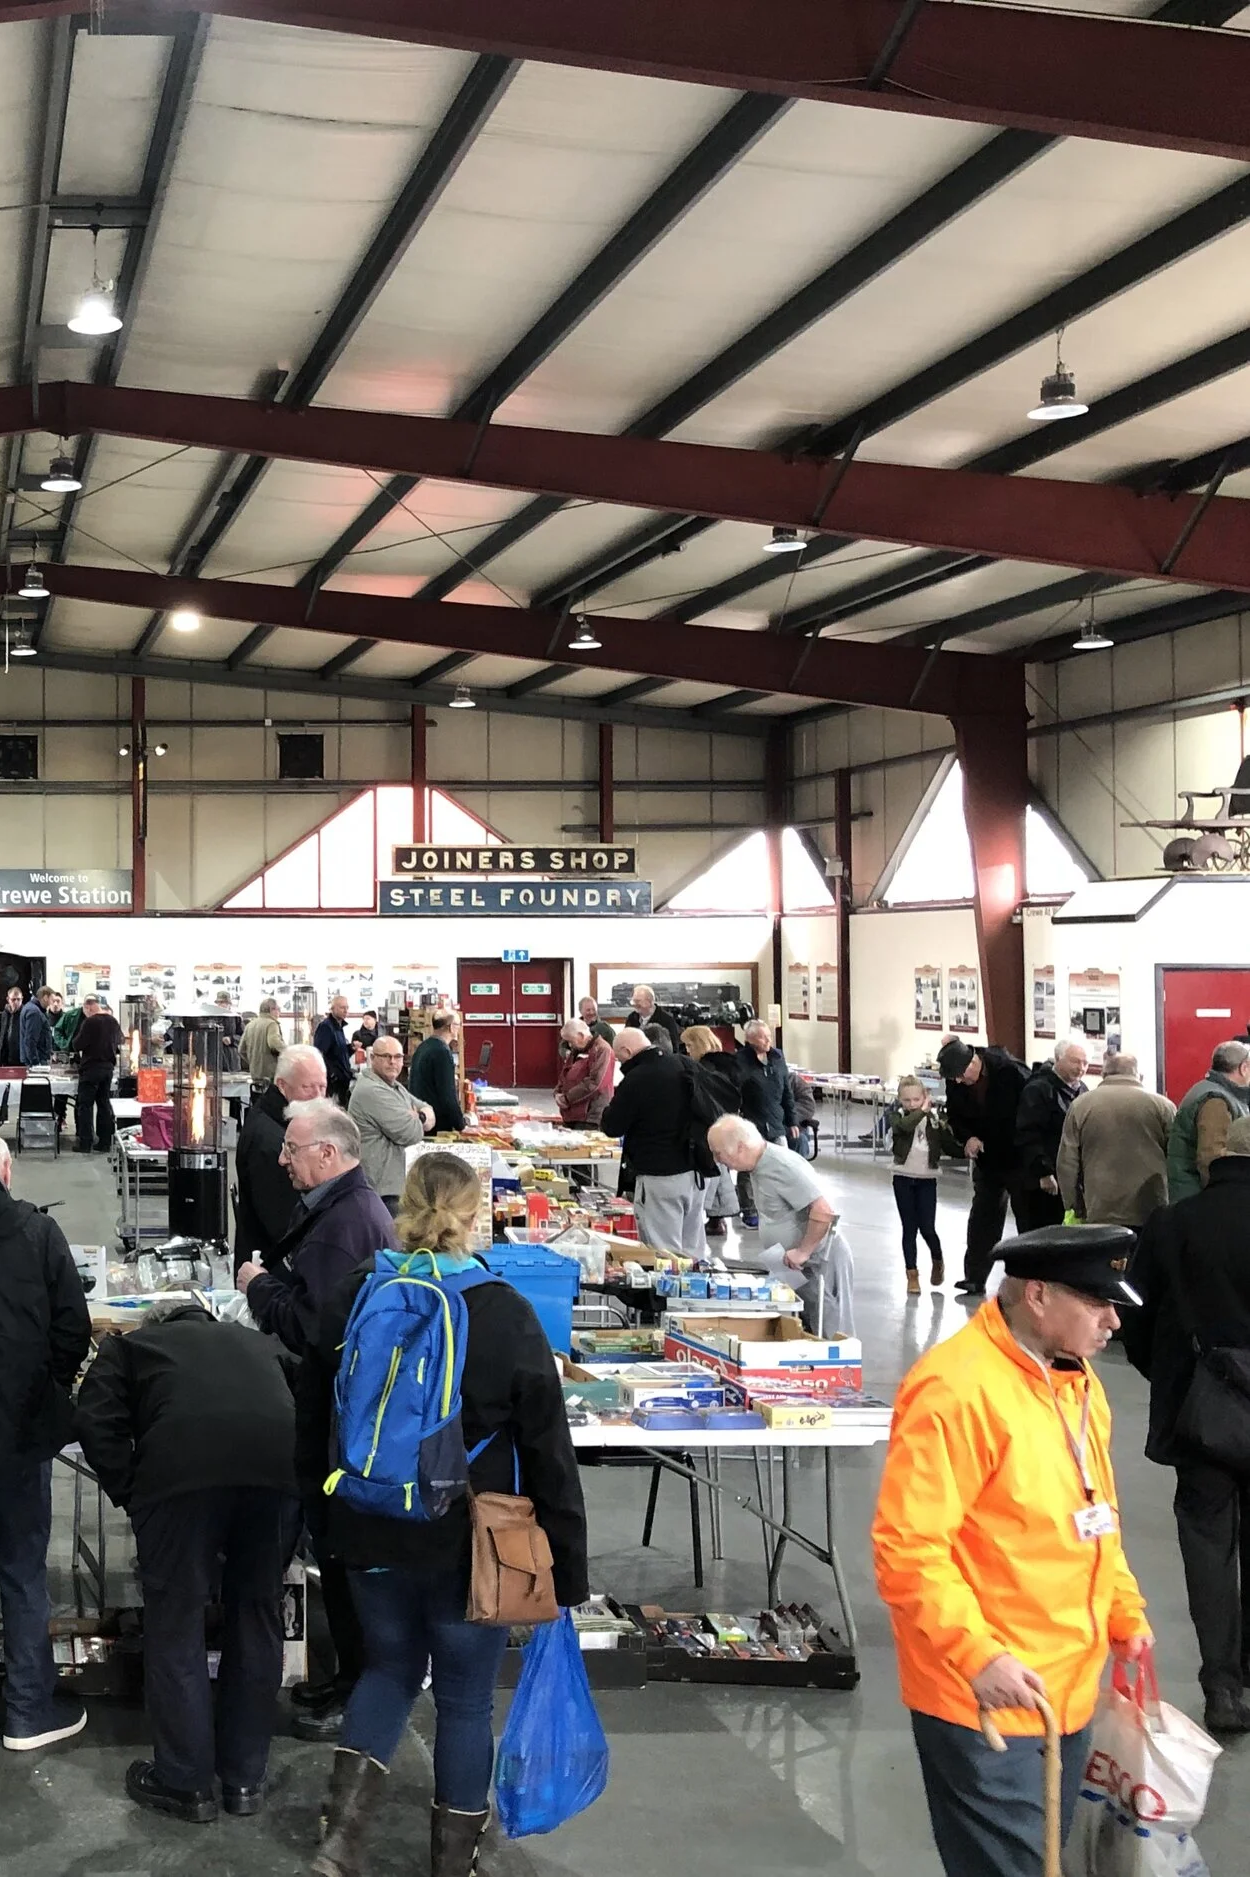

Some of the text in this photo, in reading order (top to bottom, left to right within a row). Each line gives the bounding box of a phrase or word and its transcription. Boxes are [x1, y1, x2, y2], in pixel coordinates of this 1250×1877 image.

[401, 851, 629, 870] JOINERS SHOP
[30, 873, 88, 883] Welcome to
[58, 886, 132, 905] Station
[389, 888, 642, 907] STEEL FOUNDRY
[1085, 1750, 1168, 1822] ESCO
